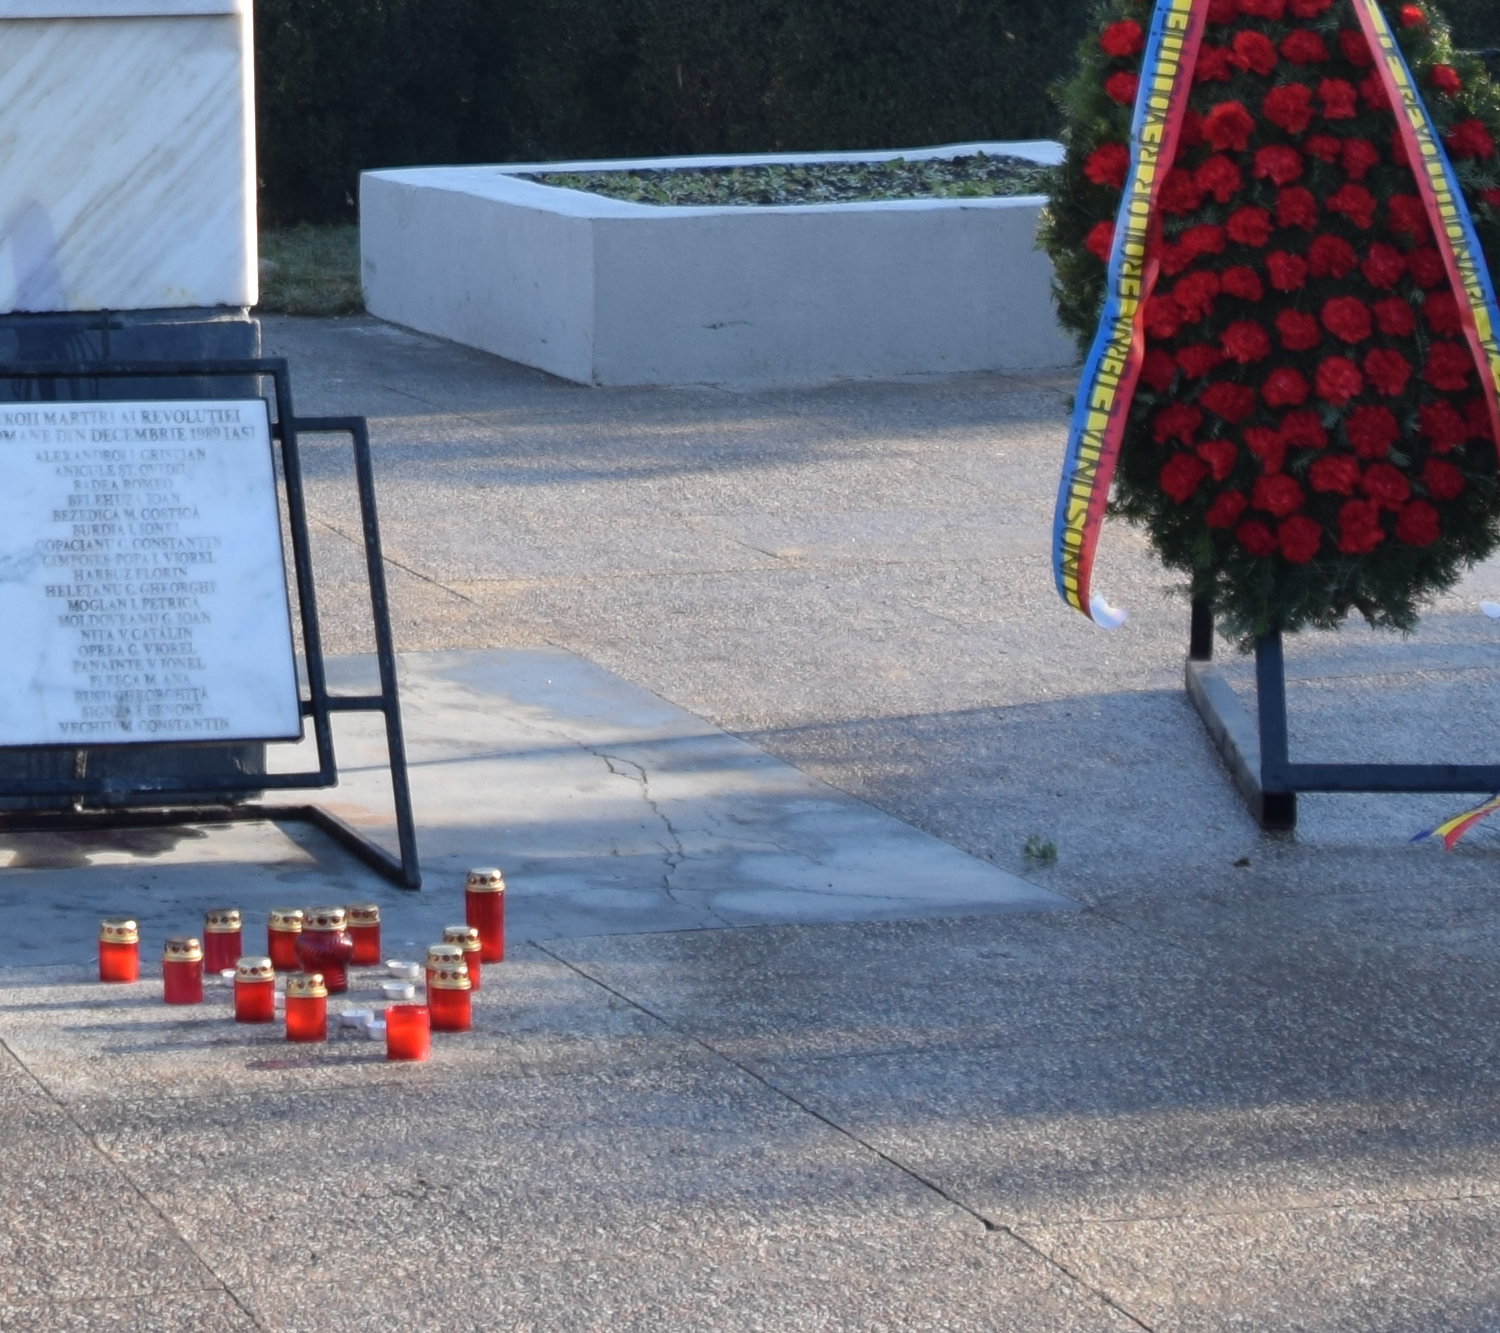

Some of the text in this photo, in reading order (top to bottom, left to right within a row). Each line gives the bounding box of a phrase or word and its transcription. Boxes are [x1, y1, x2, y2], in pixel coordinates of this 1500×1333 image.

[91, 428, 186, 443] DECEMBRIE
[190, 428, 220, 441] 1989
[67, 599, 127, 612] MOGLAN
